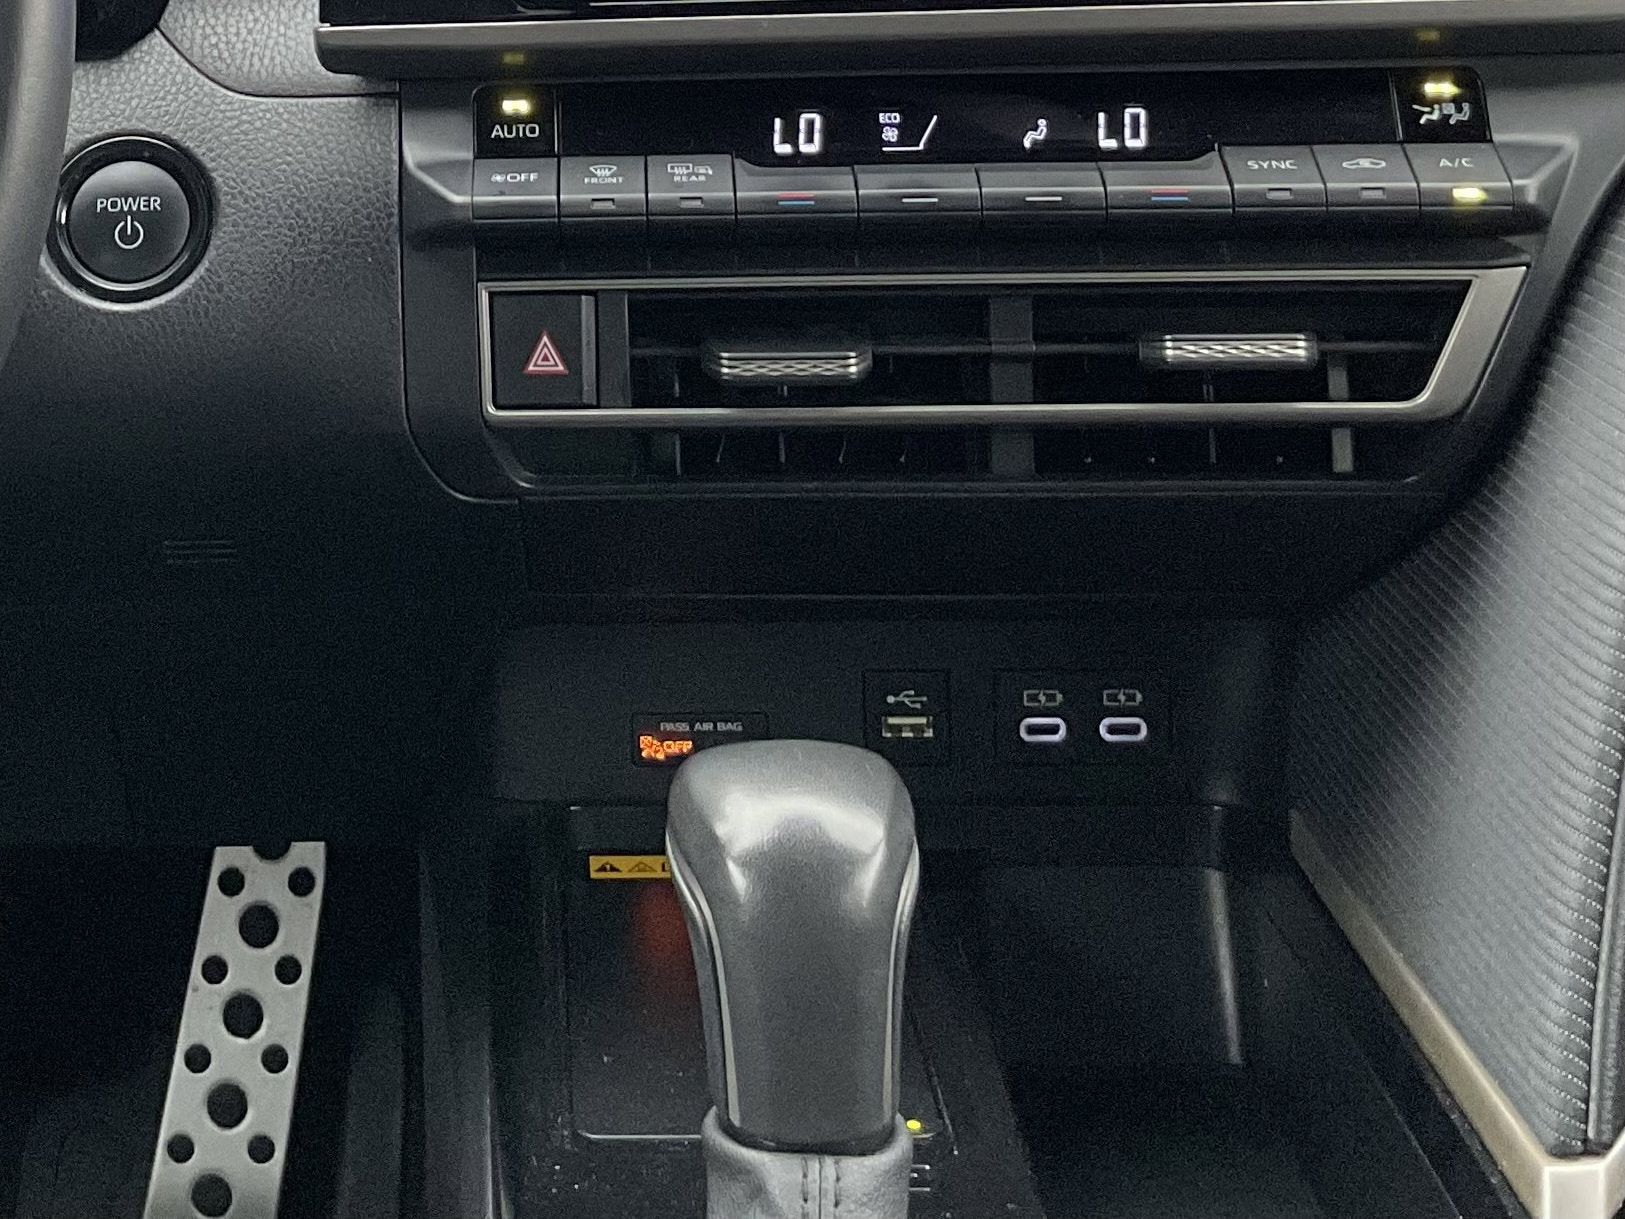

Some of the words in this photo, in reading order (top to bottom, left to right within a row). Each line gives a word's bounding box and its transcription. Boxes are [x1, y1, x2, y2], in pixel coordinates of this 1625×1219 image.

[878, 112, 901, 124] ECO
[490, 123, 540, 139] AUTO
[774, 111, 823, 154] LO
[1097, 107, 1147, 150] LO
[1247, 159, 1298, 170] SYNC
[1439, 157, 1475, 168] A/C
[507, 172, 539, 183] OFF
[584, 176, 624, 184] FRONT
[673, 175, 707, 183] REAR
[96, 195, 162, 213] POWER
[660, 721, 690, 732] PASS
[693, 721, 714, 732] AIR
[716, 721, 743, 731] BAG
[663, 740, 693, 755] OFF
